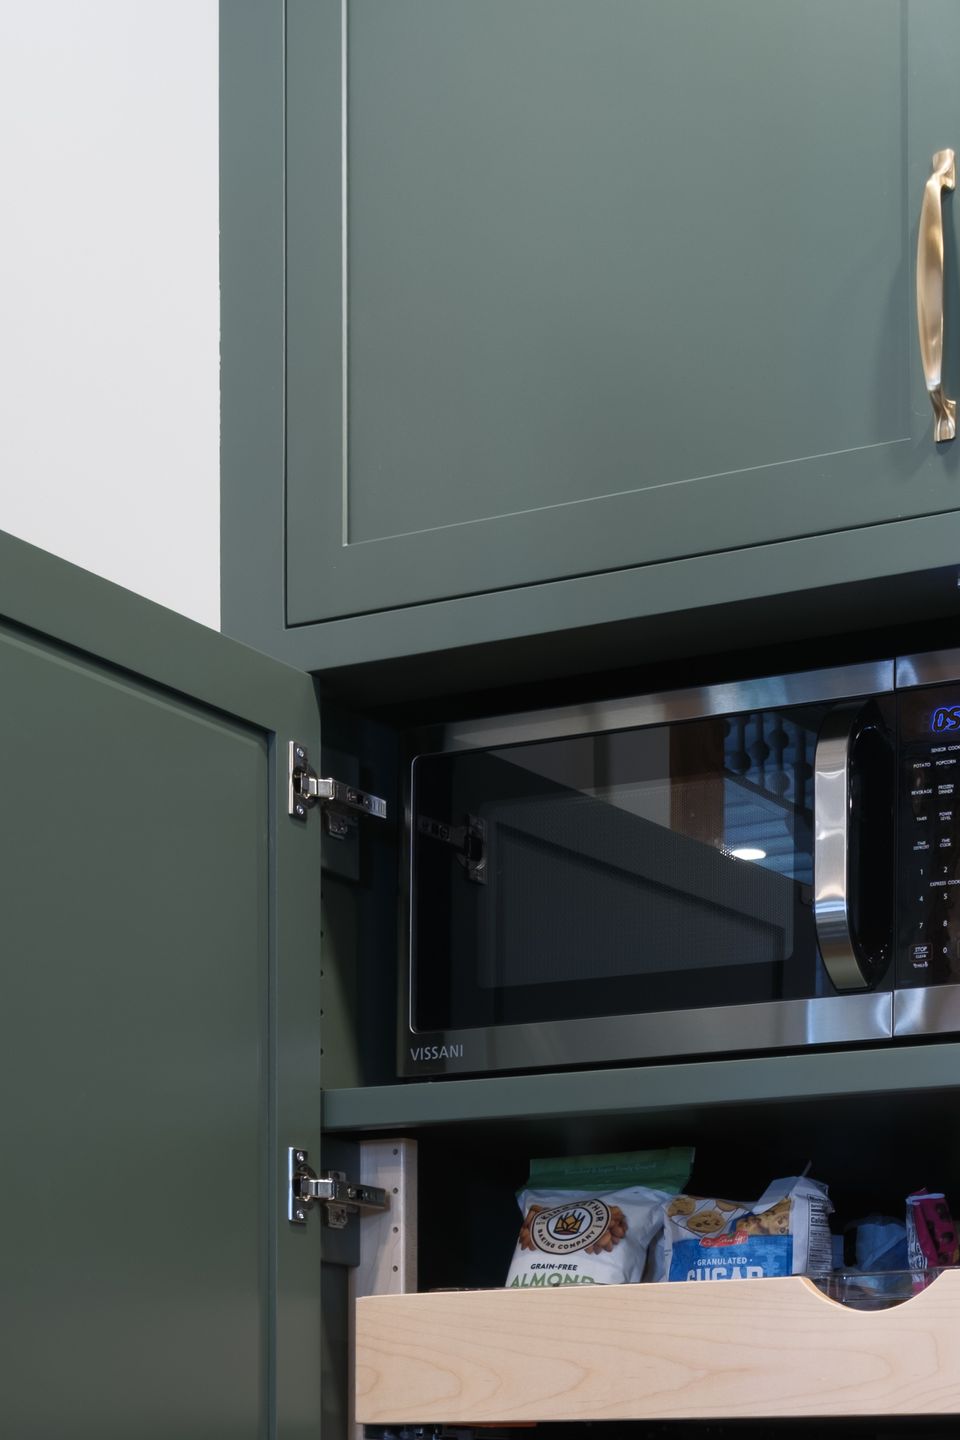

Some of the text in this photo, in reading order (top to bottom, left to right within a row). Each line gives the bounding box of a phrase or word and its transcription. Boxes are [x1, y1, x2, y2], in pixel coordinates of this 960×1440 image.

[919, 868, 924, 876] 1
[943, 892, 948, 900] 5
[943, 919, 948, 927] 8
[410, 1044, 463, 1061] VISSANI
[557, 1230, 596, 1250] COMPANY
[697, 1257, 748, 1266] GRANULATED
[530, 1263, 578, 1271] GRAIN-FREE
